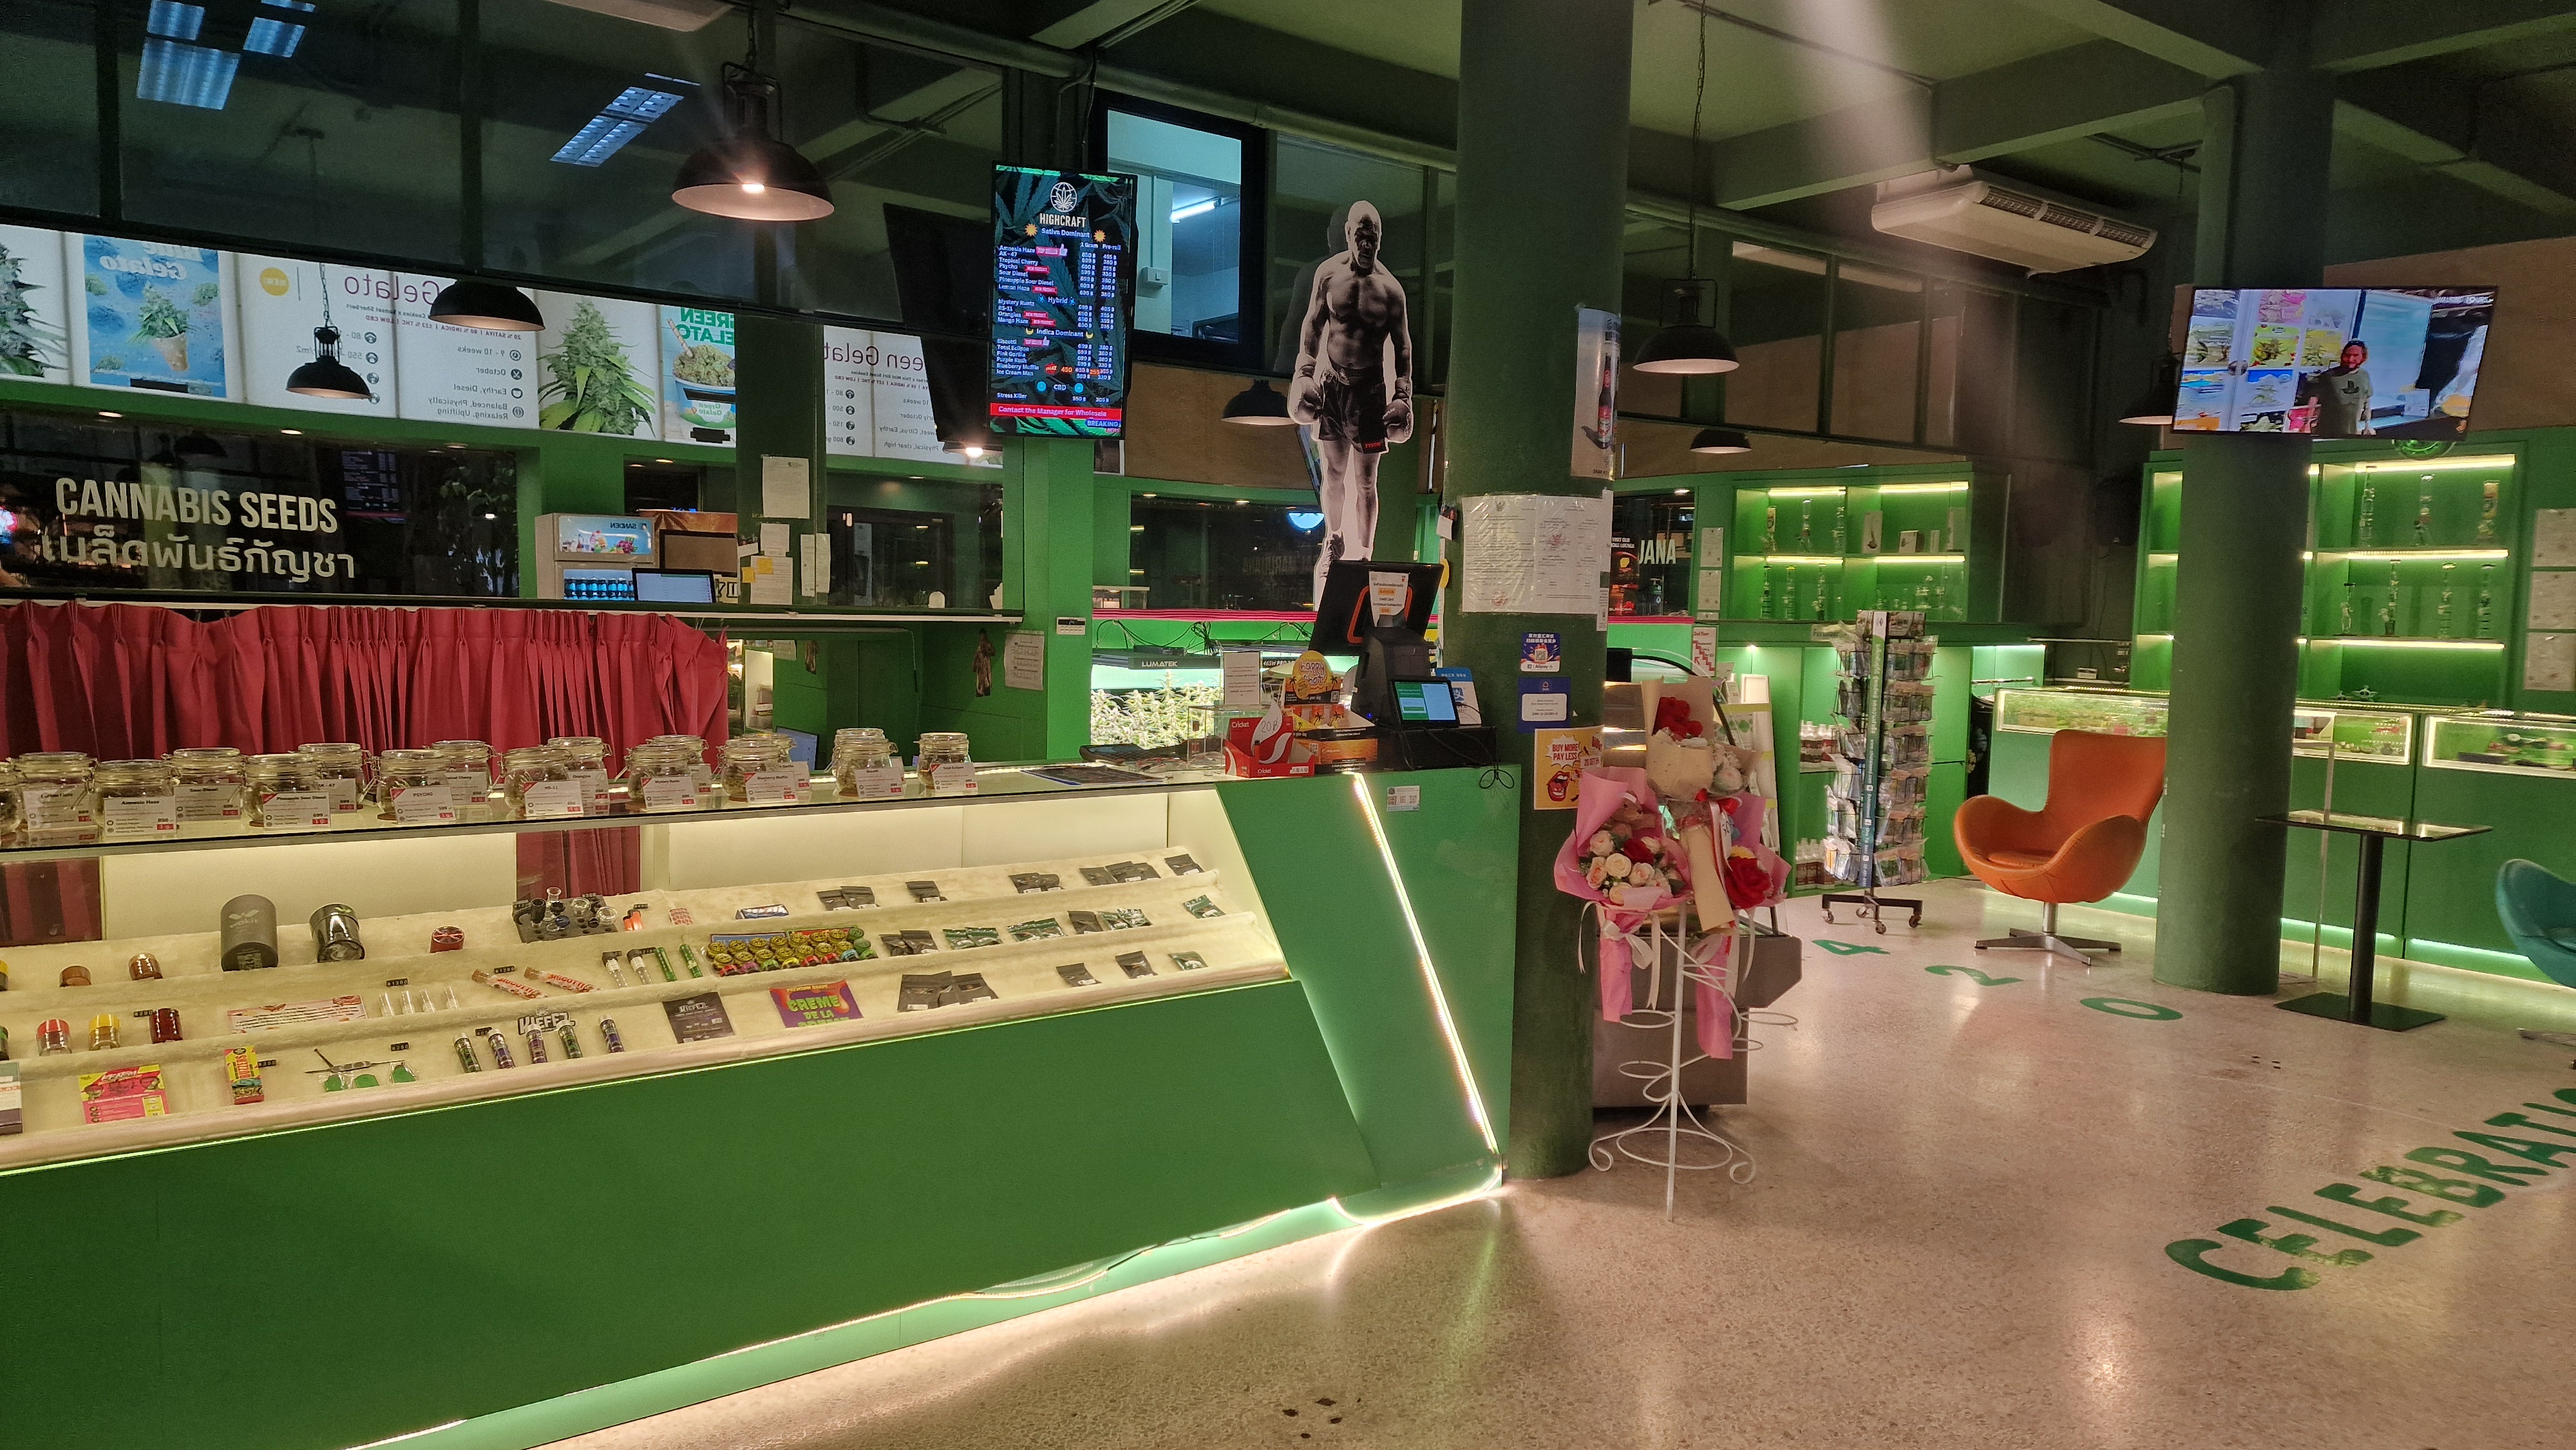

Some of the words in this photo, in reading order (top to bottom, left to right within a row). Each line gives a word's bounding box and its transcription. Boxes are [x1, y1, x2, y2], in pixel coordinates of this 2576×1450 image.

[1039, 213, 1086, 227] HIGHCRAFT
[1048, 296, 1068, 305] Hybrid
[1037, 408, 1064, 417] Manager
[55, 477, 232, 526] CANNABIS
[240, 491, 338, 534] SEEDS
[1300, 659, 1325, 675] happy
[1810, 938, 1891, 957] 4
[1923, 963, 2023, 988] 2
[786, 995, 841, 1012] CREME
[804, 1012, 820, 1020] DE
[821, 1010, 835, 1019] LA
